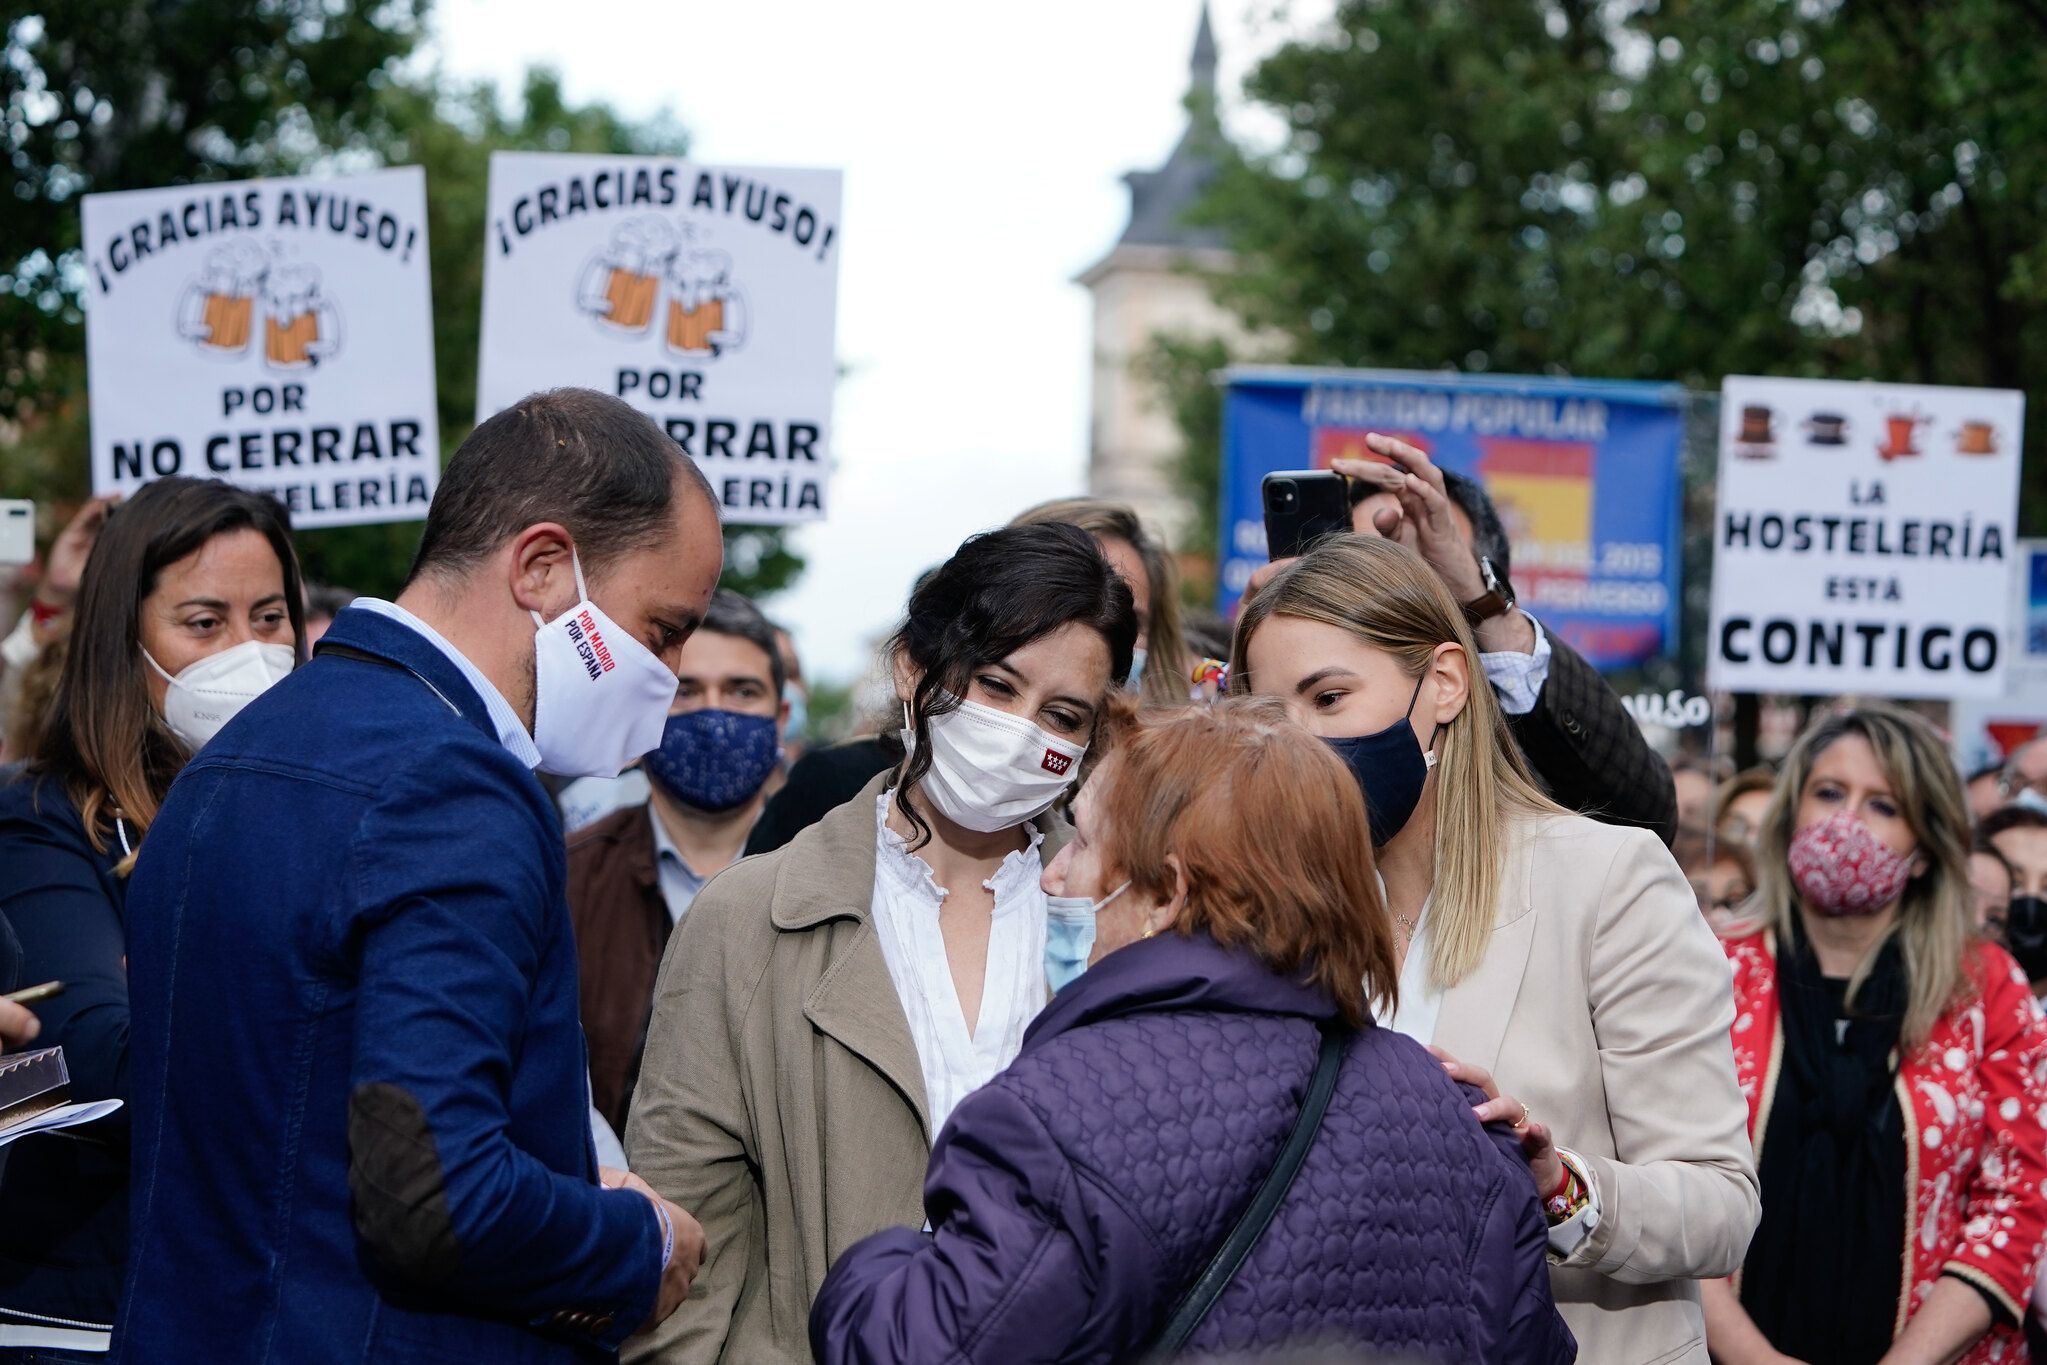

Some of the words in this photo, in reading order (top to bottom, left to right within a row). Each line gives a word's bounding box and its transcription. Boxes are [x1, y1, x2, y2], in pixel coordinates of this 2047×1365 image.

[94, 190, 261, 293] ¡GRACIAS
[277, 190, 417, 262] AYUSO!
[495, 168, 677, 257] ¡GRACIAS
[693, 172, 835, 260] AYUSO!
[223, 385, 305, 416] POR
[616, 369, 704, 400] POR
[113, 440, 183, 479] NO
[206, 421, 422, 472] CERRAR
[666, 419, 820, 461] RRAR
[1849, 481, 1886, 503] LA
[1724, 513, 2004, 560] HOSTELERÍA
[565, 619, 584, 643] POR
[576, 641, 602, 682] ESPAÑA
[577, 610, 596, 635] POR
[589, 632, 615, 672] MADRID
[1721, 619, 1998, 674] CONTIGO
